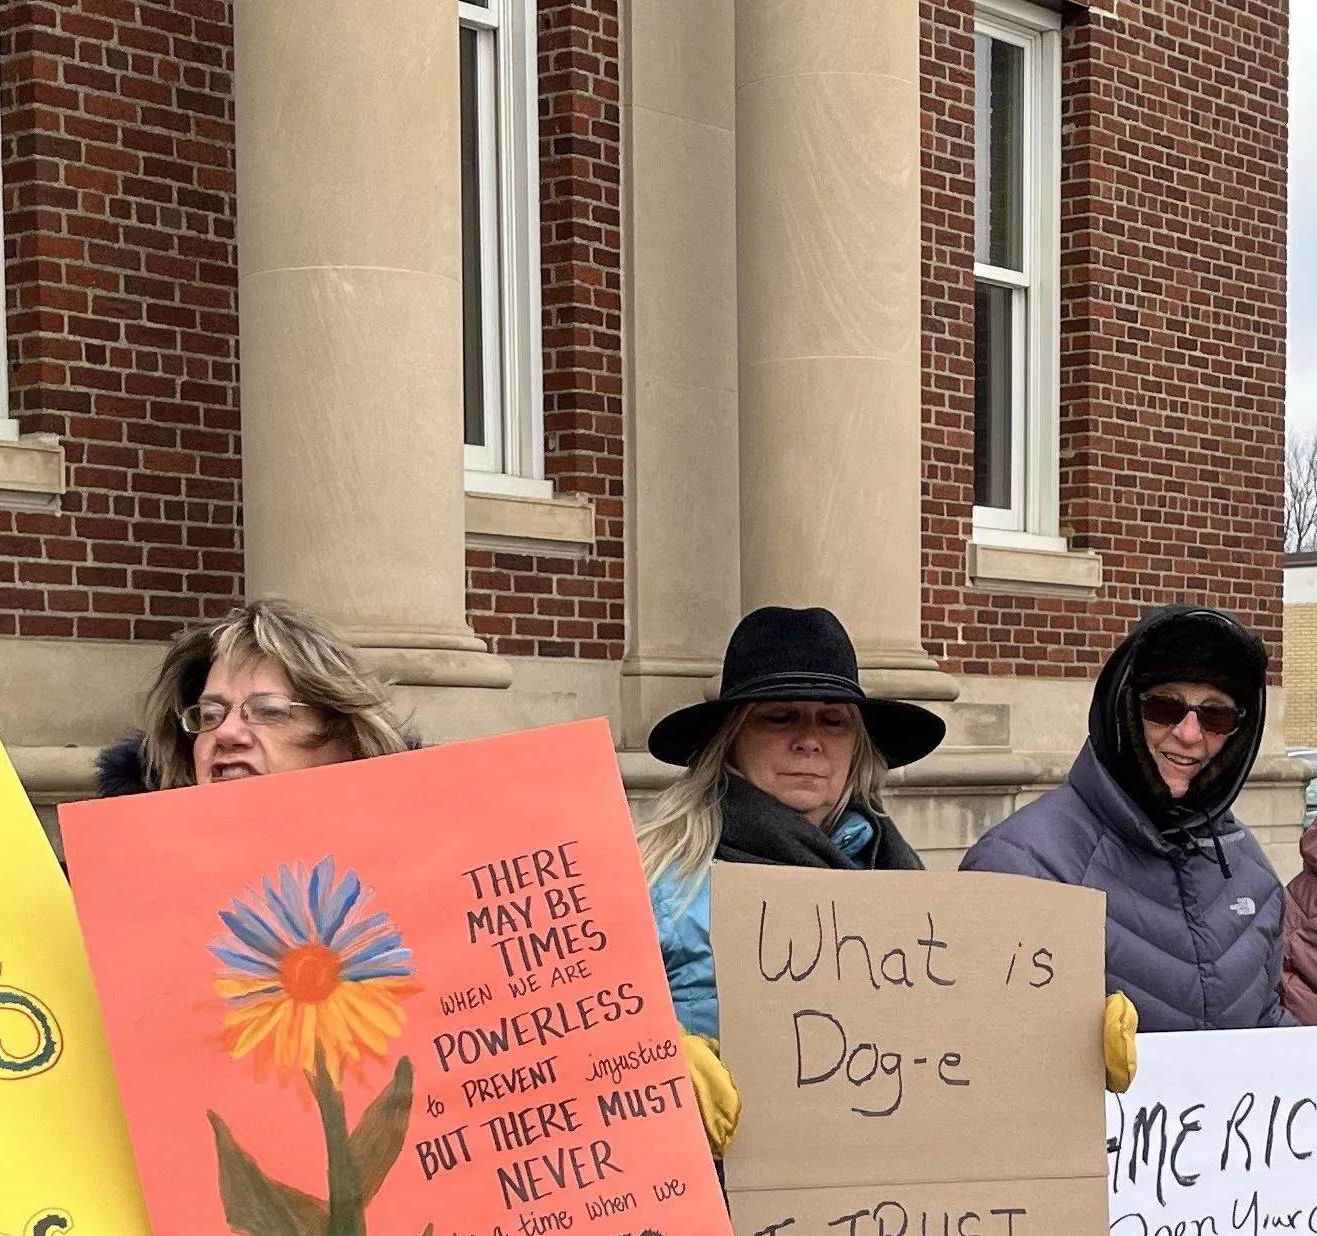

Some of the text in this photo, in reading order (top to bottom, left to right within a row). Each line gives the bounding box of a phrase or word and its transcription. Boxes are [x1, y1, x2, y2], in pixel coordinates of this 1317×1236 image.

[461, 841, 582, 900] THERE
[467, 883, 592, 944] MAY BE
[491, 919, 607, 978] TIMES
[758, 900, 1054, 990] What is
[440, 959, 592, 1017] WHEN WE ARE
[434, 982, 645, 1073] POWERLESS
[793, 1009, 970, 1117] Dog-e
[426, 1036, 679, 1120] to PREVENT injustice
[415, 1075, 685, 1181] BUT THERE MUST
[497, 1139, 623, 1210] NEVER
[519, 1202, 573, 1236] time
[585, 1187, 637, 1221] when
[653, 1177, 686, 1201] we
